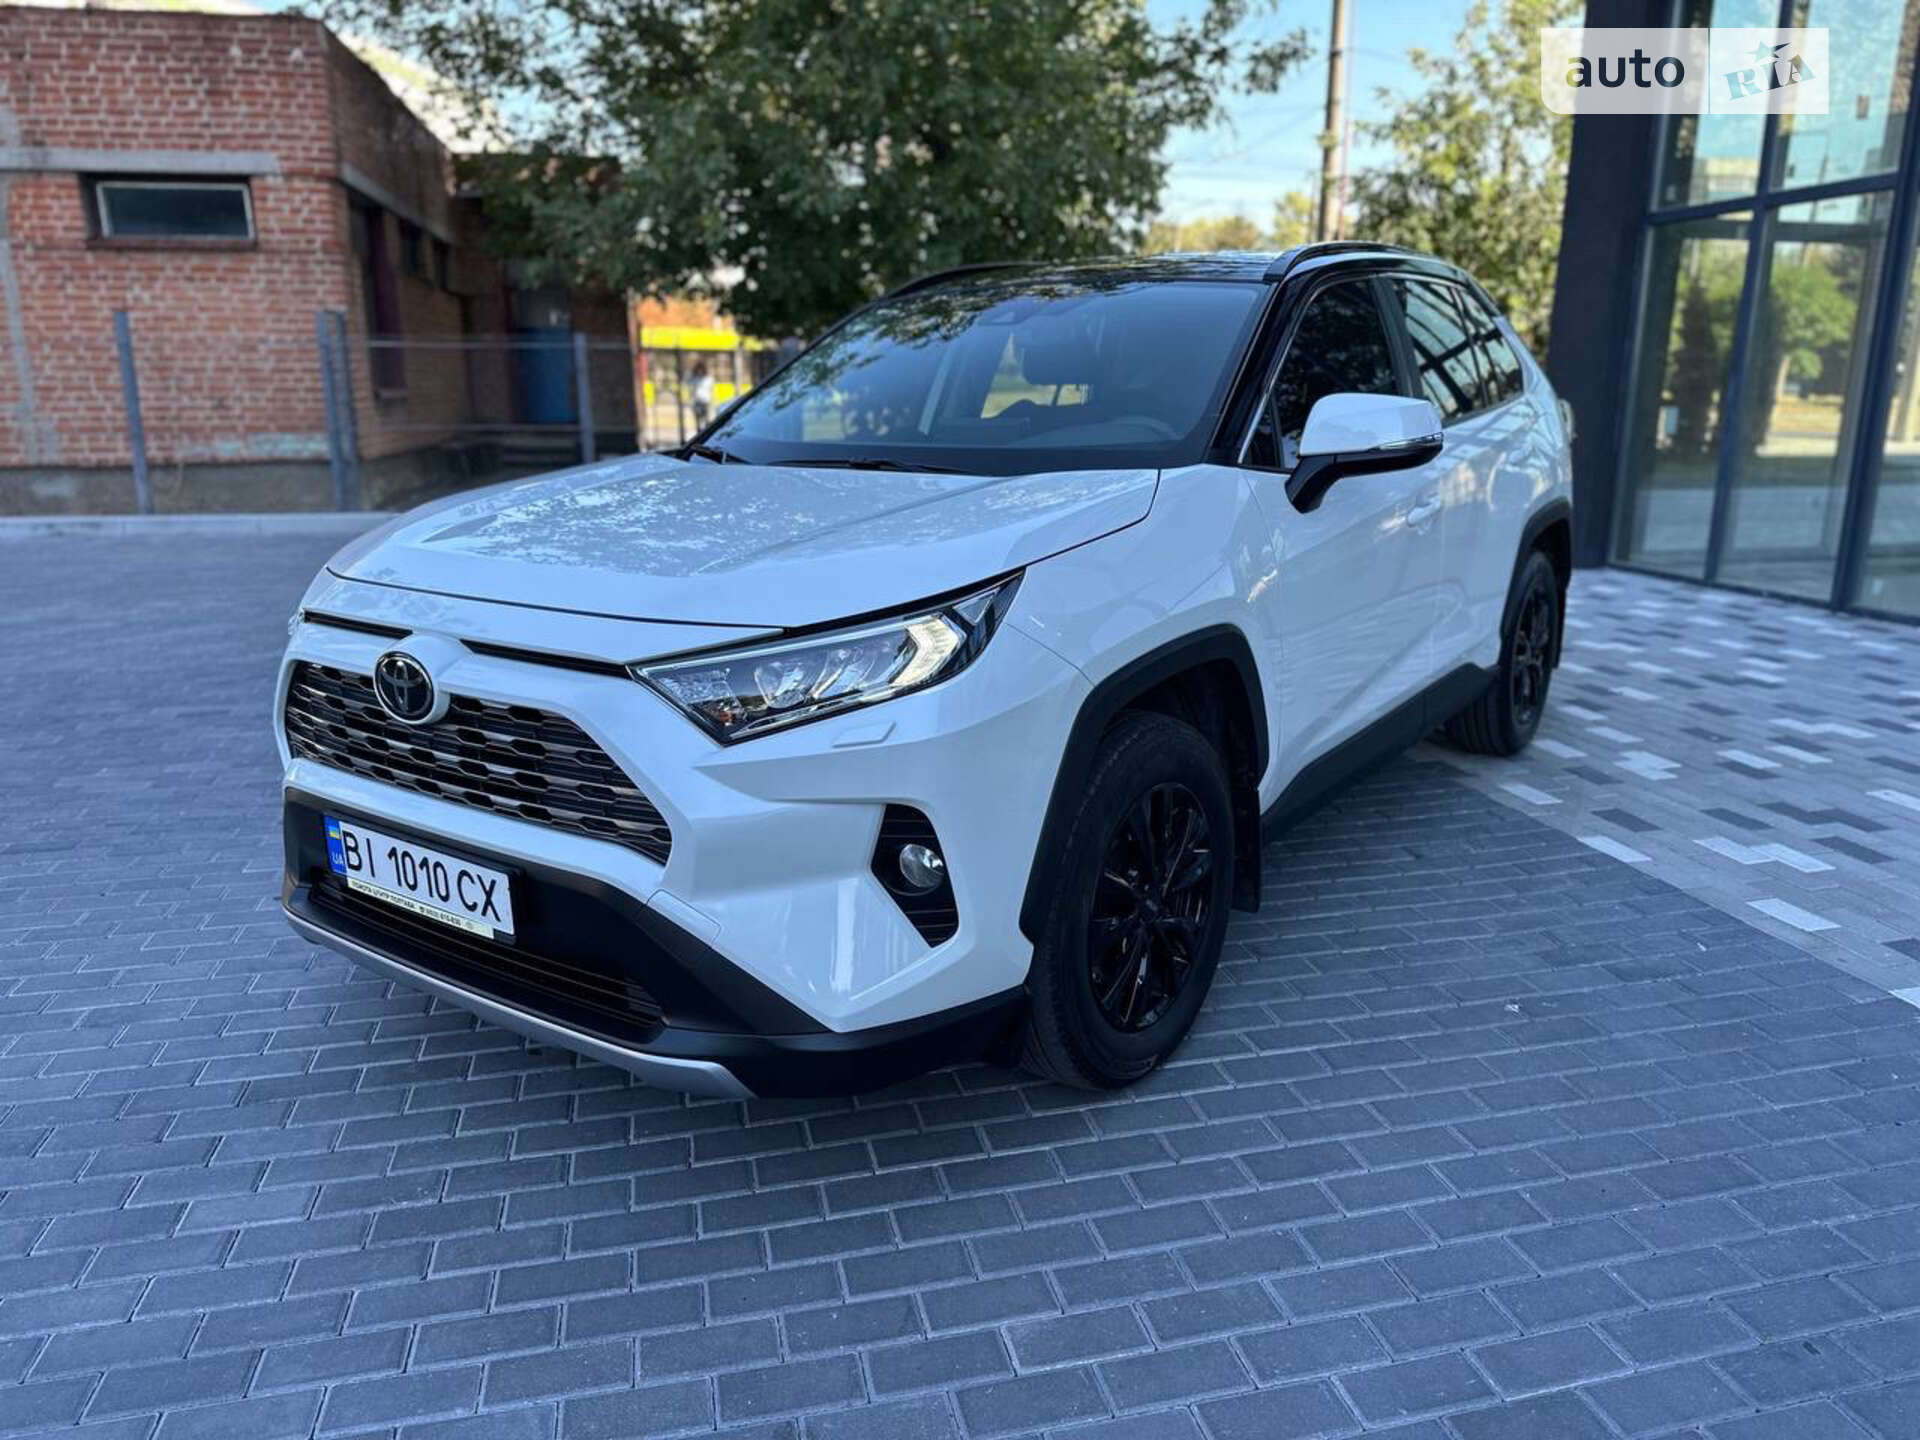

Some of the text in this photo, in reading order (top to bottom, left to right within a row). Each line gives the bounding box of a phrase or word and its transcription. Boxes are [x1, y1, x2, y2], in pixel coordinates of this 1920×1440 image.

[332, 853, 344, 865] UA
[342, 831, 376, 878] BI
[387, 846, 450, 903] 1010
[456, 869, 502, 922] CX
